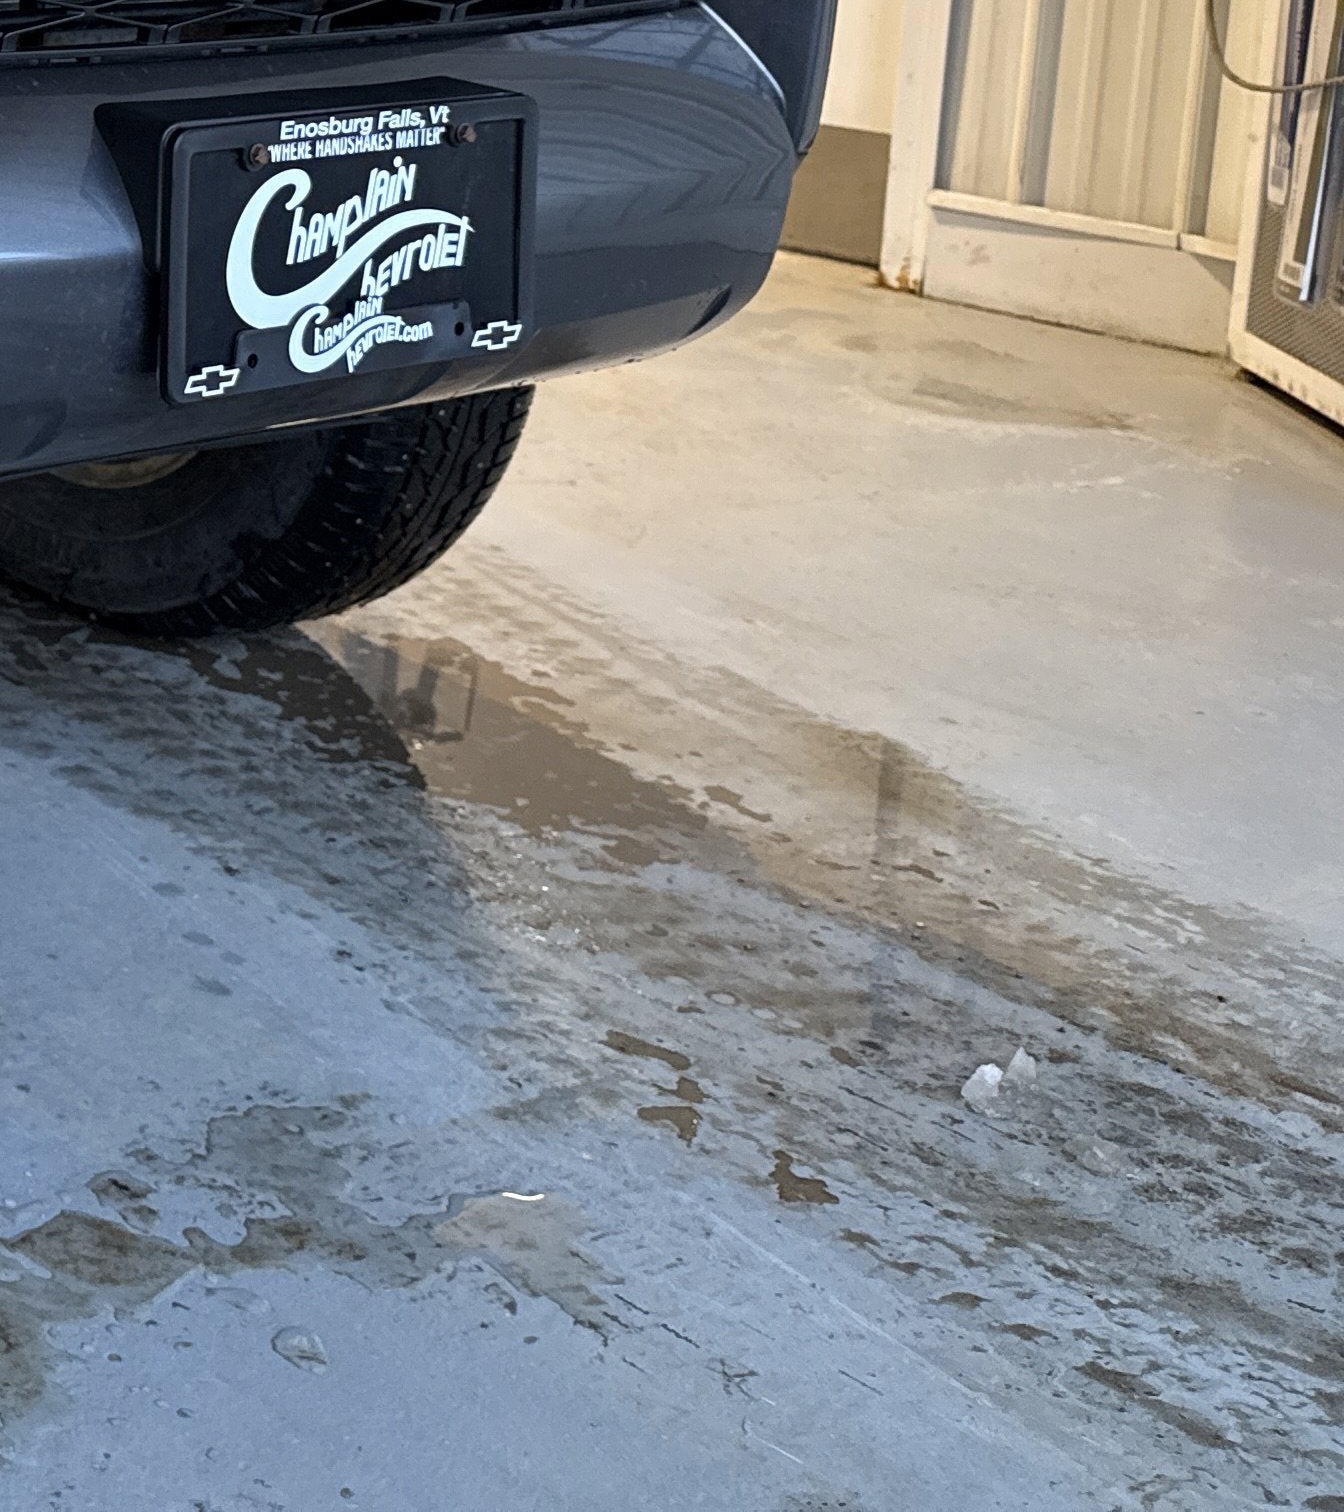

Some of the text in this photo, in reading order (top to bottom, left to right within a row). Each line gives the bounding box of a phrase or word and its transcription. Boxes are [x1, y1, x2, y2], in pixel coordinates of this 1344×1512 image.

[279, 105, 451, 140] Enosburg Falls, Vt
[315, 131, 393, 157] HANDSHAKES
